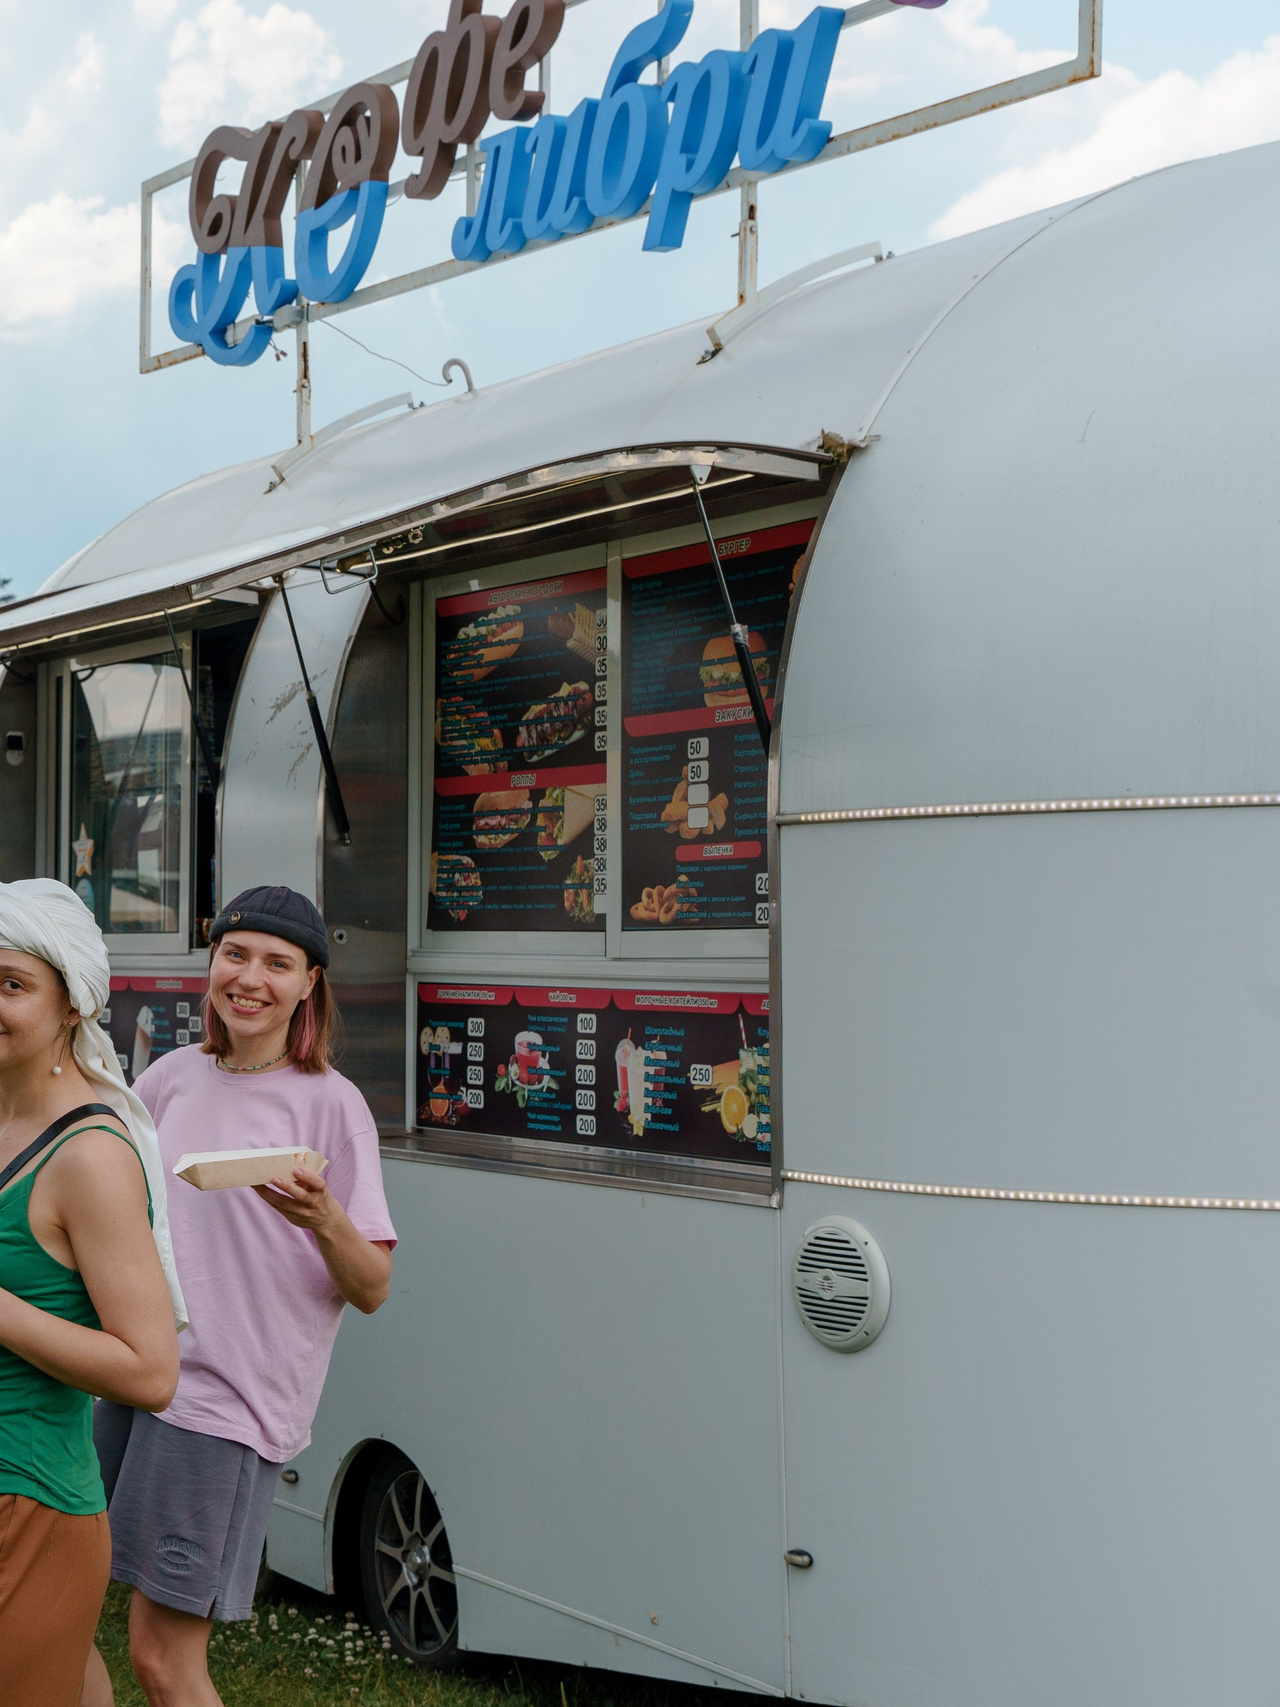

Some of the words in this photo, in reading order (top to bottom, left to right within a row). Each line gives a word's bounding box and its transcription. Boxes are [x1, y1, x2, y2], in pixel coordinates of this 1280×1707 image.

[718, 537, 751, 557] БУРГЕР
[488, 586, 527, 605] АВТОРСКИЕ
[689, 740, 701, 756] 50
[690, 765, 702, 780] 50
[510, 773, 536, 788] РОЛЛЫ
[703, 844, 734, 857] ВЫПЕЧКА
[757, 907, 769, 921] 20
[457, 990, 480, 1000] НАПИТКИ
[548, 990, 559, 1002] ЧАЙ
[635, 995, 668, 1005] МОЛОЧНЫЕ
[668, 995, 699, 1006] КОКТЕЙЛИ
[699, 997, 709, 1007] 350
[709, 1000, 718, 1008] мл
[527, 1014, 537, 1022] Чай
[579, 1017, 593, 1031] 100
[470, 1021, 483, 1034] 300
[644, 1025, 685, 1037] Шоколадный
[469, 1045, 482, 1058] 250
[578, 1042, 594, 1057] 200
[644, 1042, 683, 1053] Клубничный
[644, 1057, 680, 1068] Малиновый
[469, 1068, 482, 1081] 250
[577, 1068, 594, 1083] 200
[644, 1072, 686, 1084] Карамельный
[692, 1067, 710, 1082] 250
[469, 1092, 482, 1105] 200
[577, 1093, 594, 1107] 200
[644, 1088, 677, 1100] Кокосовый
[644, 1104, 672, 1115] Бабл-гам
[579, 1118, 595, 1132] 200
[644, 1119, 680, 1131] Сливочный
